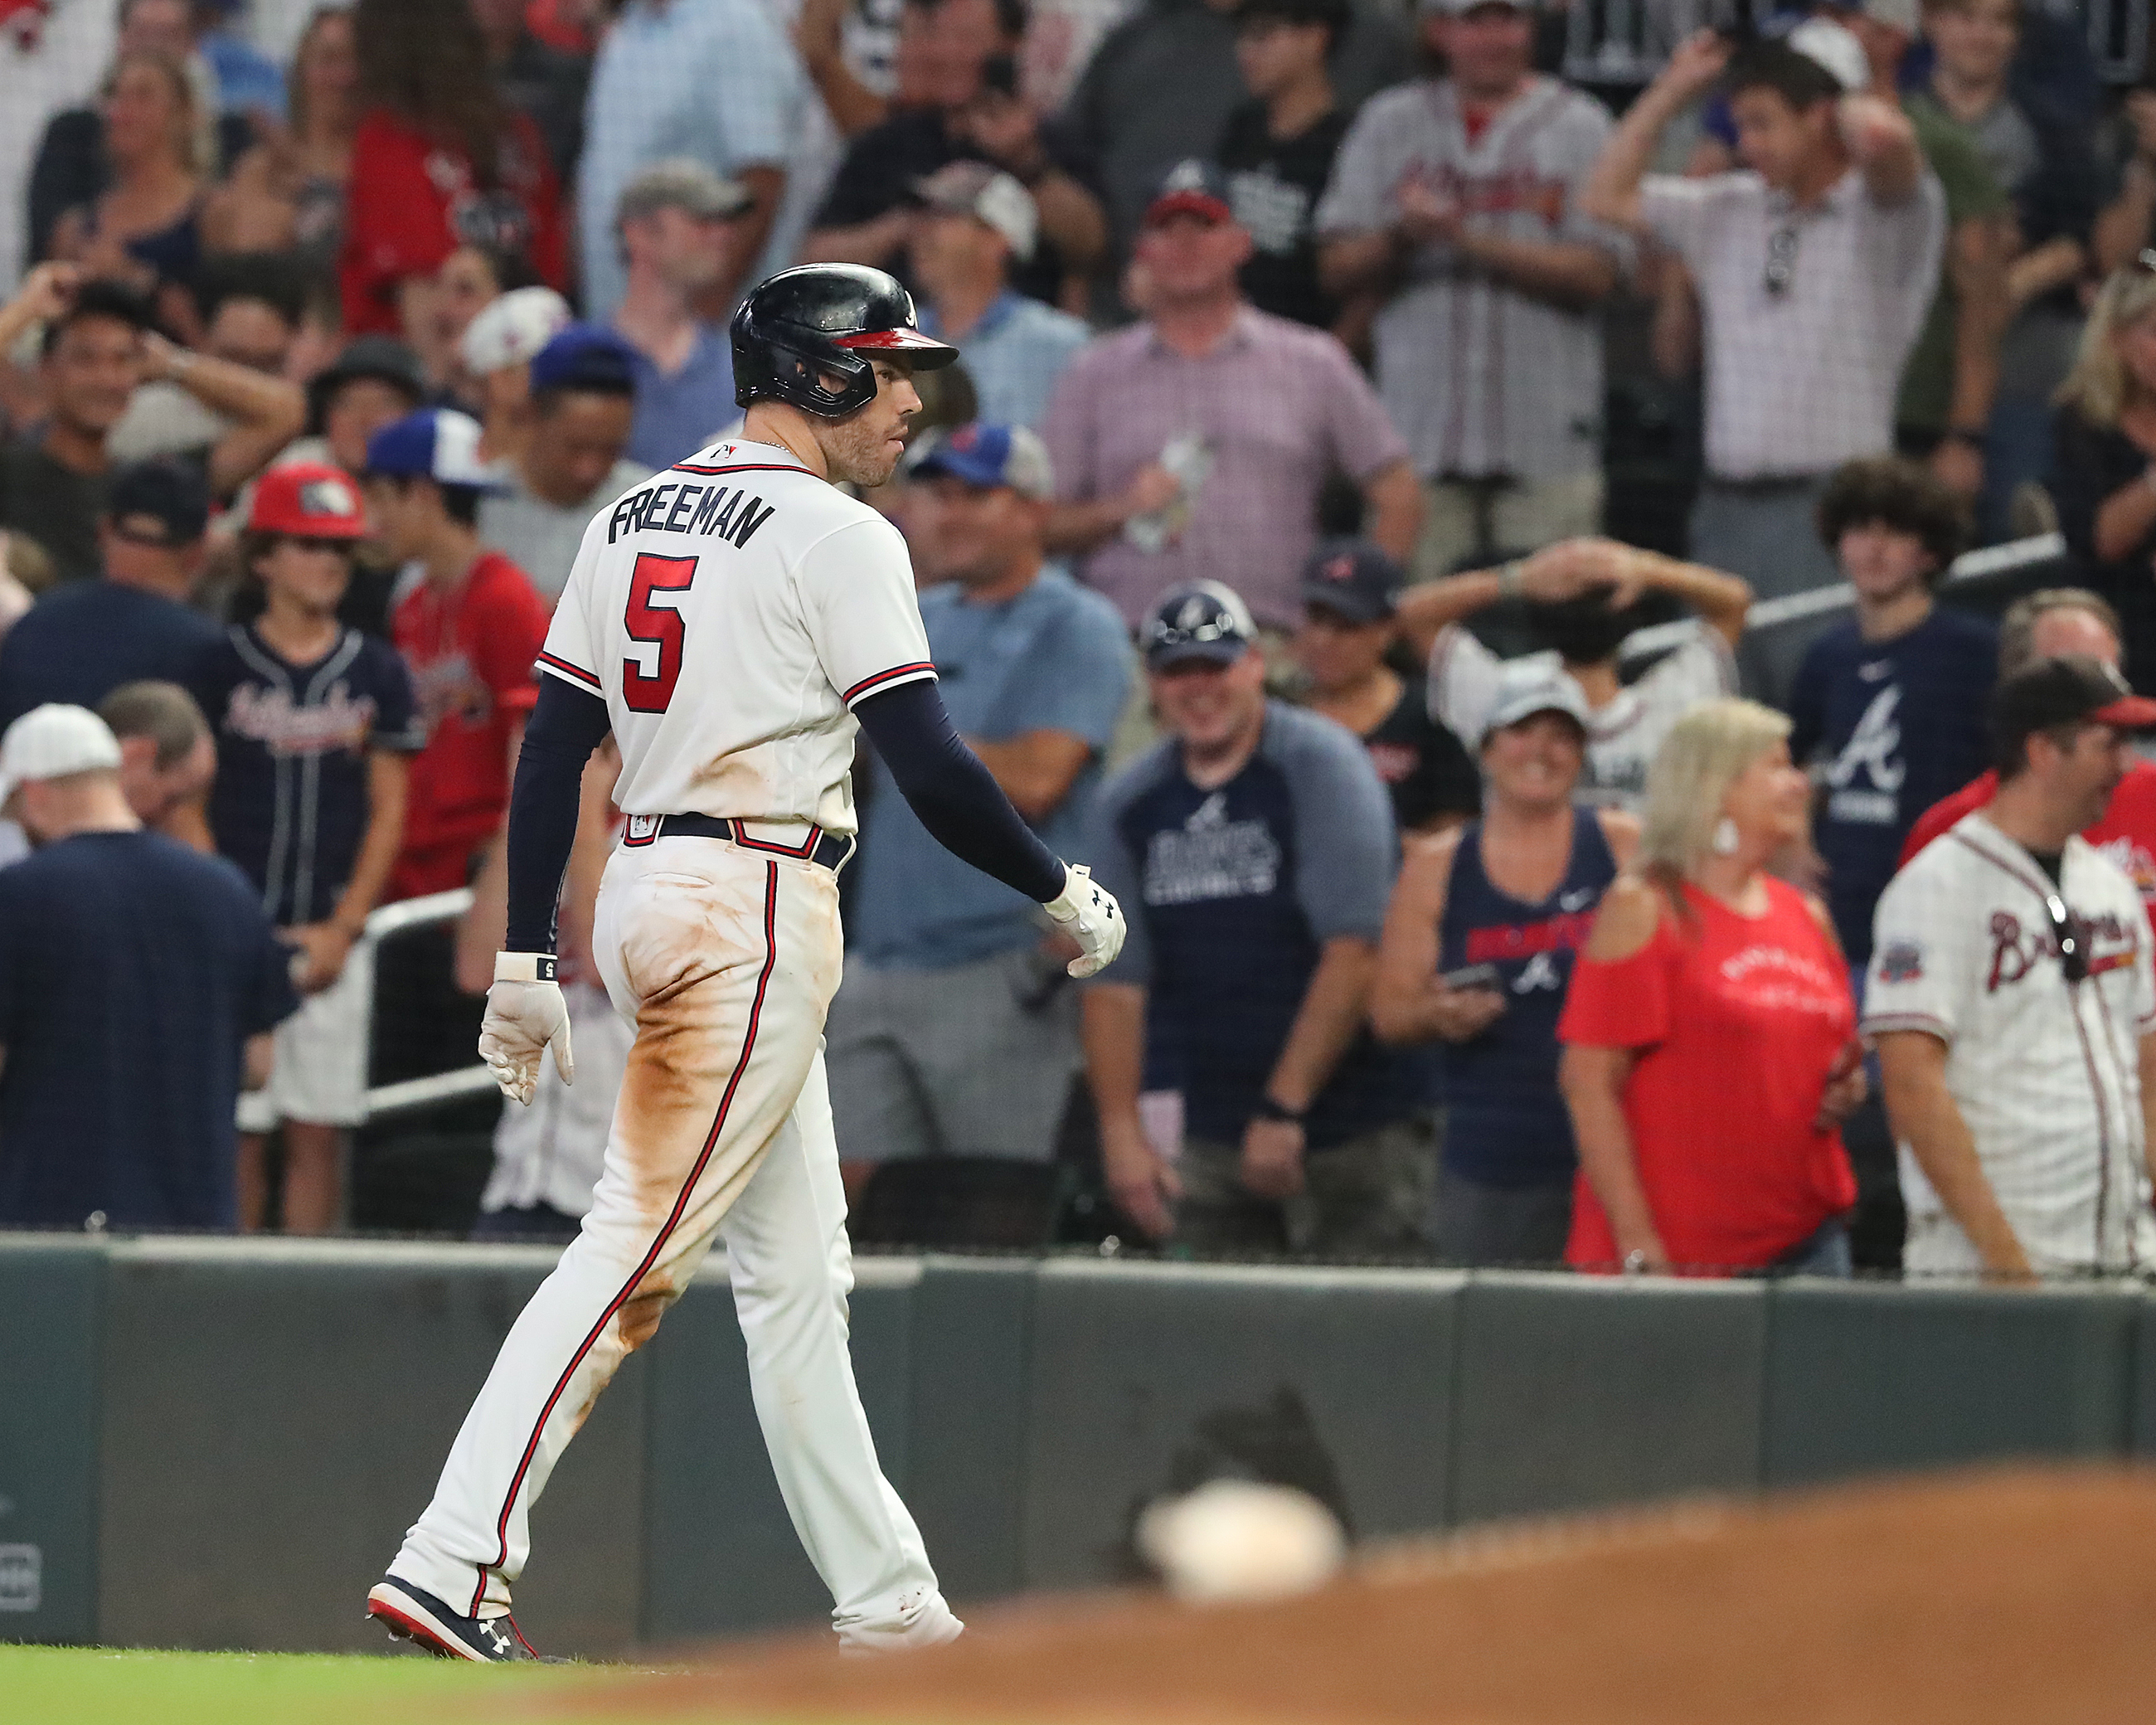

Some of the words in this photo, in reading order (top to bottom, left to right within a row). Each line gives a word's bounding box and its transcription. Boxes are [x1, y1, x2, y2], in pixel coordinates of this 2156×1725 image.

[607, 483, 776, 550] FREEMAN
[622, 552, 700, 715] 5
[1826, 683, 1906, 793] A
[545, 961, 555, 979] 5
[1988, 910, 2133, 993] Bres
